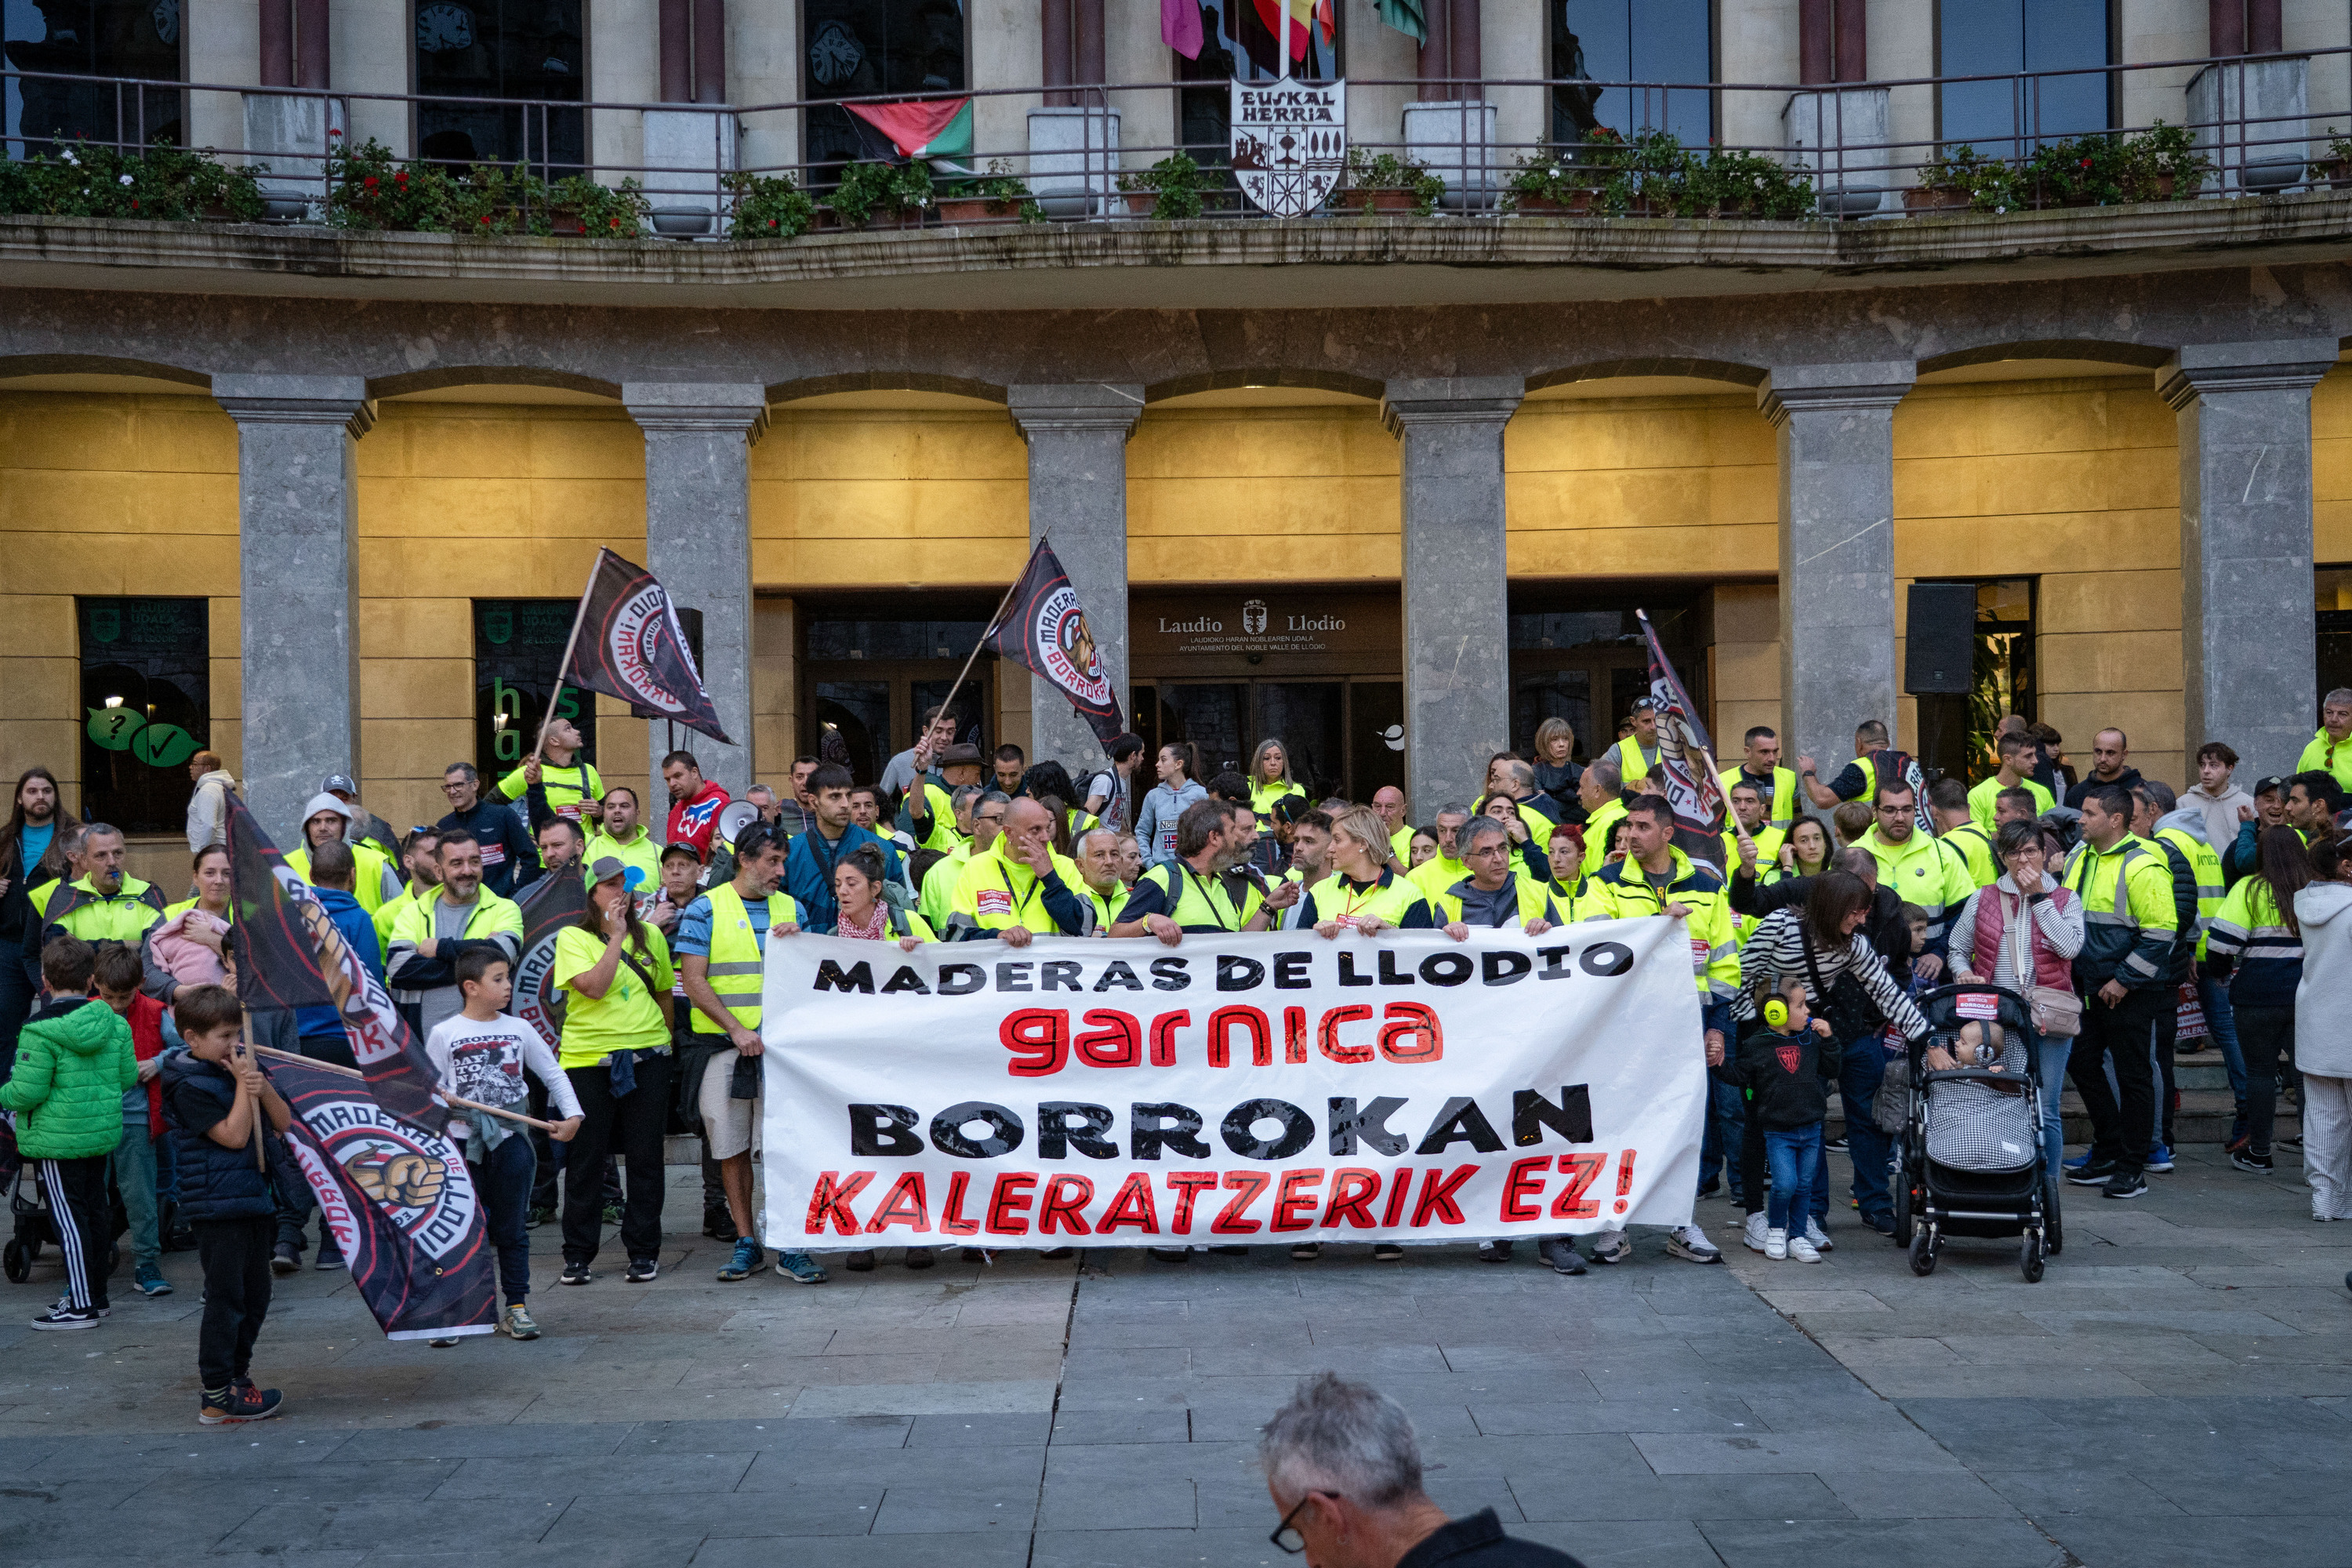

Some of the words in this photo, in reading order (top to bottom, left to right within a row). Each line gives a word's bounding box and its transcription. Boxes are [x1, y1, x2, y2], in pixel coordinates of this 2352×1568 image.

[1240, 92, 1335, 106] EUSKAL
[1159, 617, 1222, 633] Laudio
[1287, 615, 1345, 631] Llodio
[815, 956, 1191, 995] MADERAS
[1215, 952, 1312, 992] DE
[1338, 942, 1633, 986] LLODIO
[451, 1034, 522, 1049] CHOPPER
[999, 1002, 1443, 1076] garnica
[850, 1083, 1593, 1159] BORROKAN
[446, 1157, 463, 1174] DE
[416, 1176, 470, 1253] LLODI
[805, 1164, 1480, 1236] KALERATZERIK
[1501, 1149, 1637, 1223] EZ!
